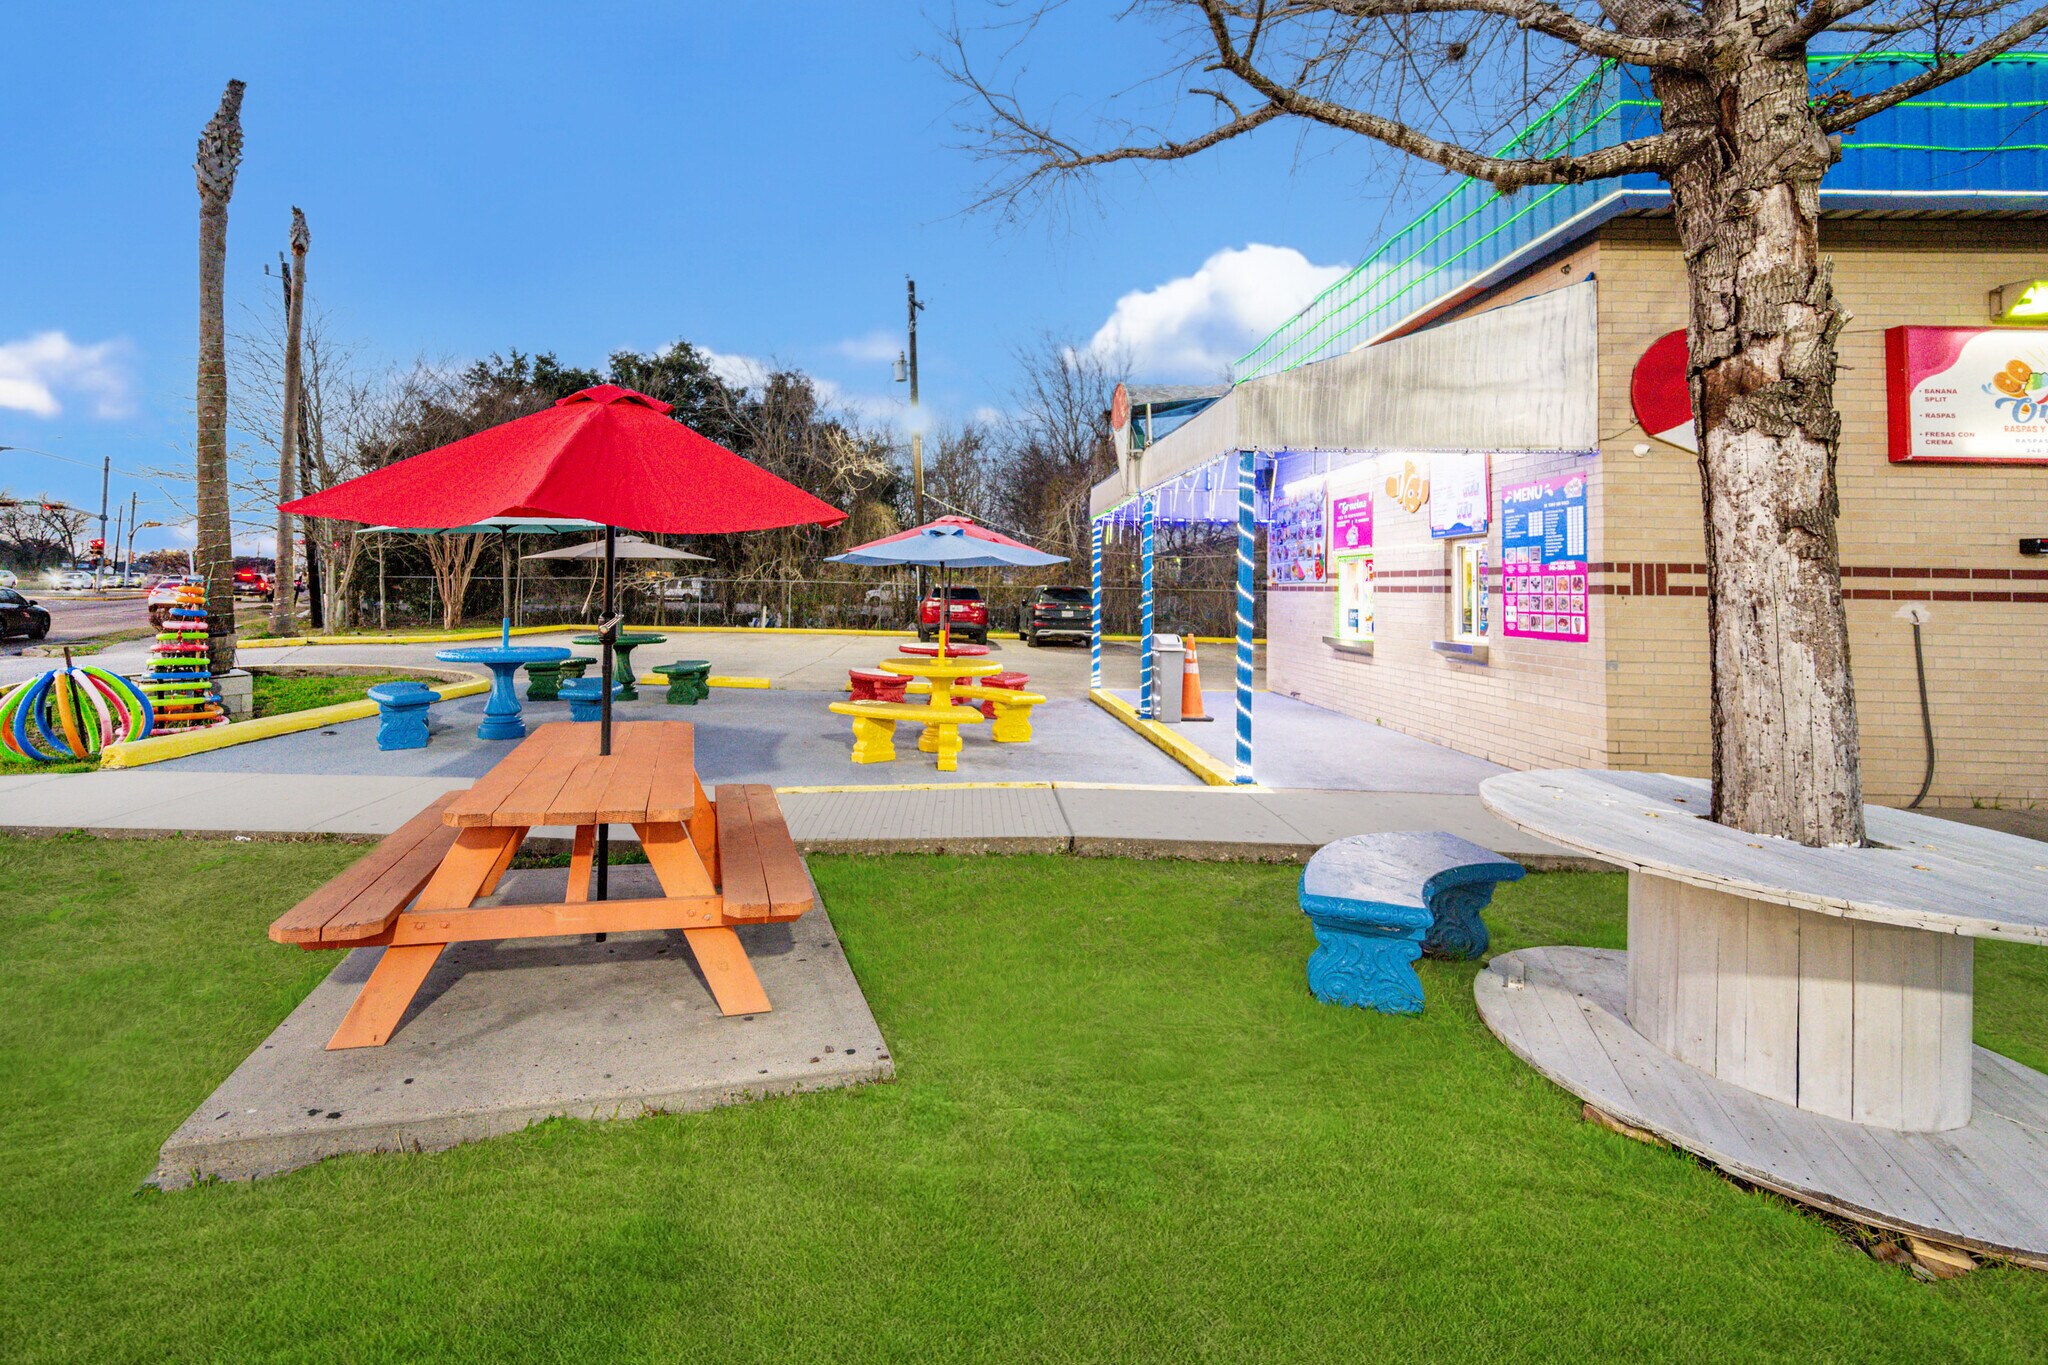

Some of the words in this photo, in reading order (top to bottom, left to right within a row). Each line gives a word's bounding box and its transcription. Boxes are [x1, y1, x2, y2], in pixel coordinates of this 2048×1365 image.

[2003, 425, 2038, 433] RASPAS
[2040, 425, 2046, 433] Y
[1513, 484, 1543, 503] MENU
